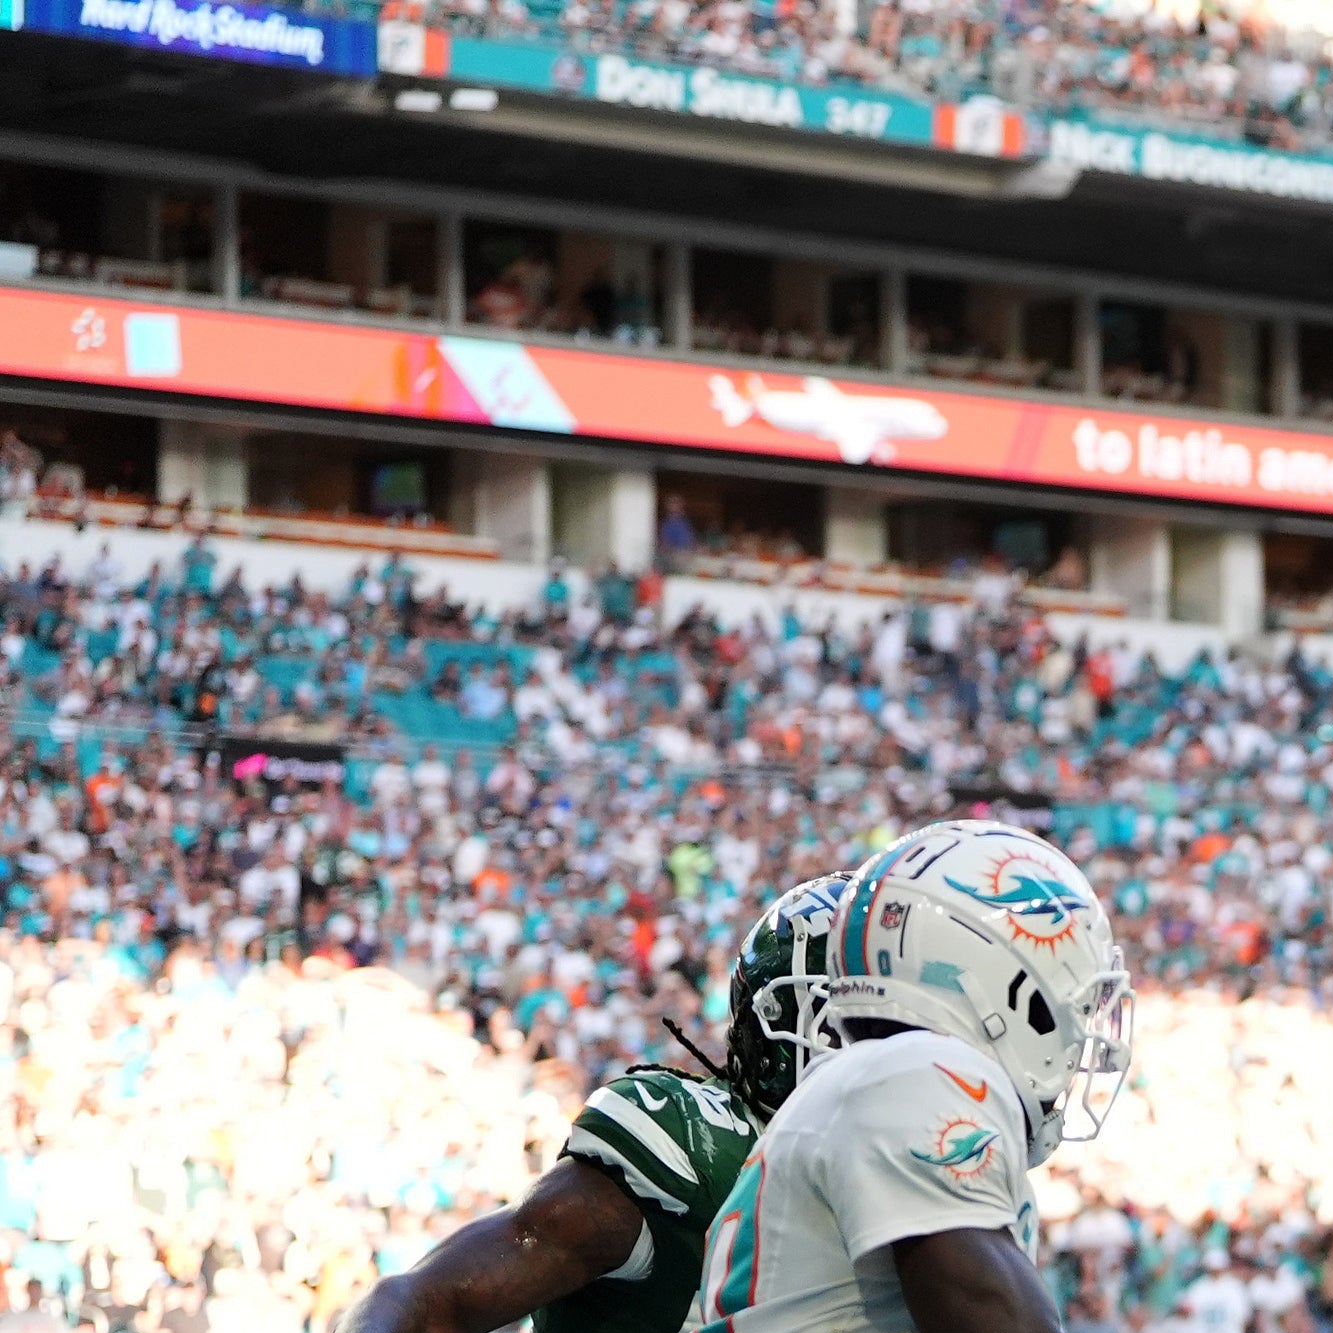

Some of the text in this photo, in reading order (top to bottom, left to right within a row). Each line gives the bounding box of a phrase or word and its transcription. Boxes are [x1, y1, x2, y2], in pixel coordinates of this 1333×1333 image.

[213, 4, 324, 65] Stadium
[1073, 418, 1132, 474] to
[1138, 423, 1252, 488] latin
